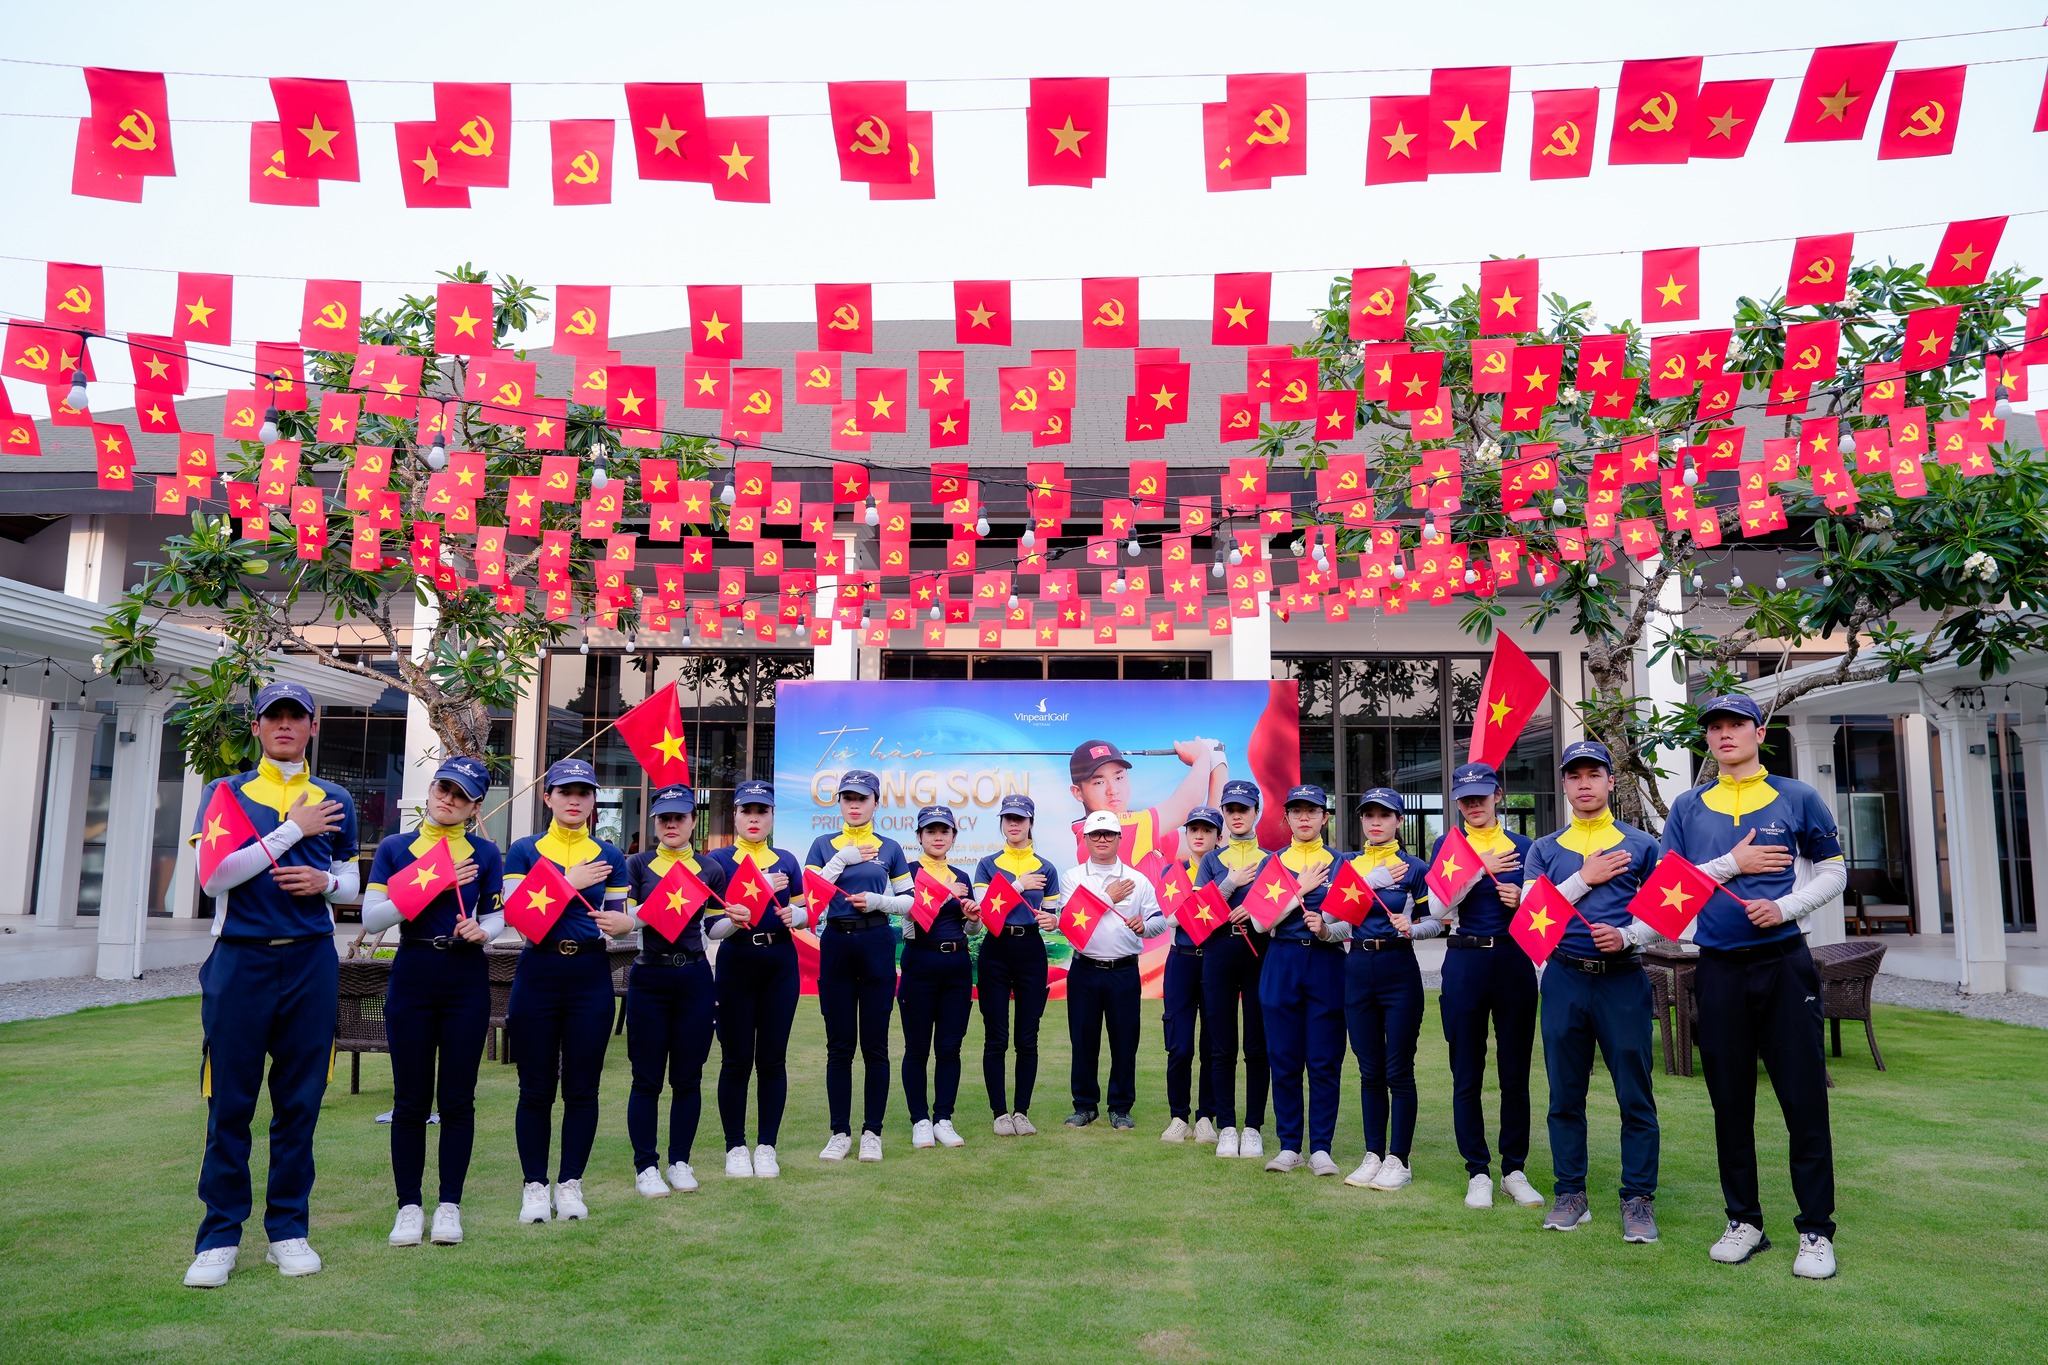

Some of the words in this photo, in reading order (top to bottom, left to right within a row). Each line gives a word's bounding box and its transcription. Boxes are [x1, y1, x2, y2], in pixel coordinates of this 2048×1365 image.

[1013, 712, 1070, 723] VinpearlGolf
[870, 737, 935, 760] hào
[811, 769, 936, 808] GNG
[947, 767, 1030, 808] SƠN
[812, 814, 845, 830] PRID
[880, 815, 915, 831] OUR
